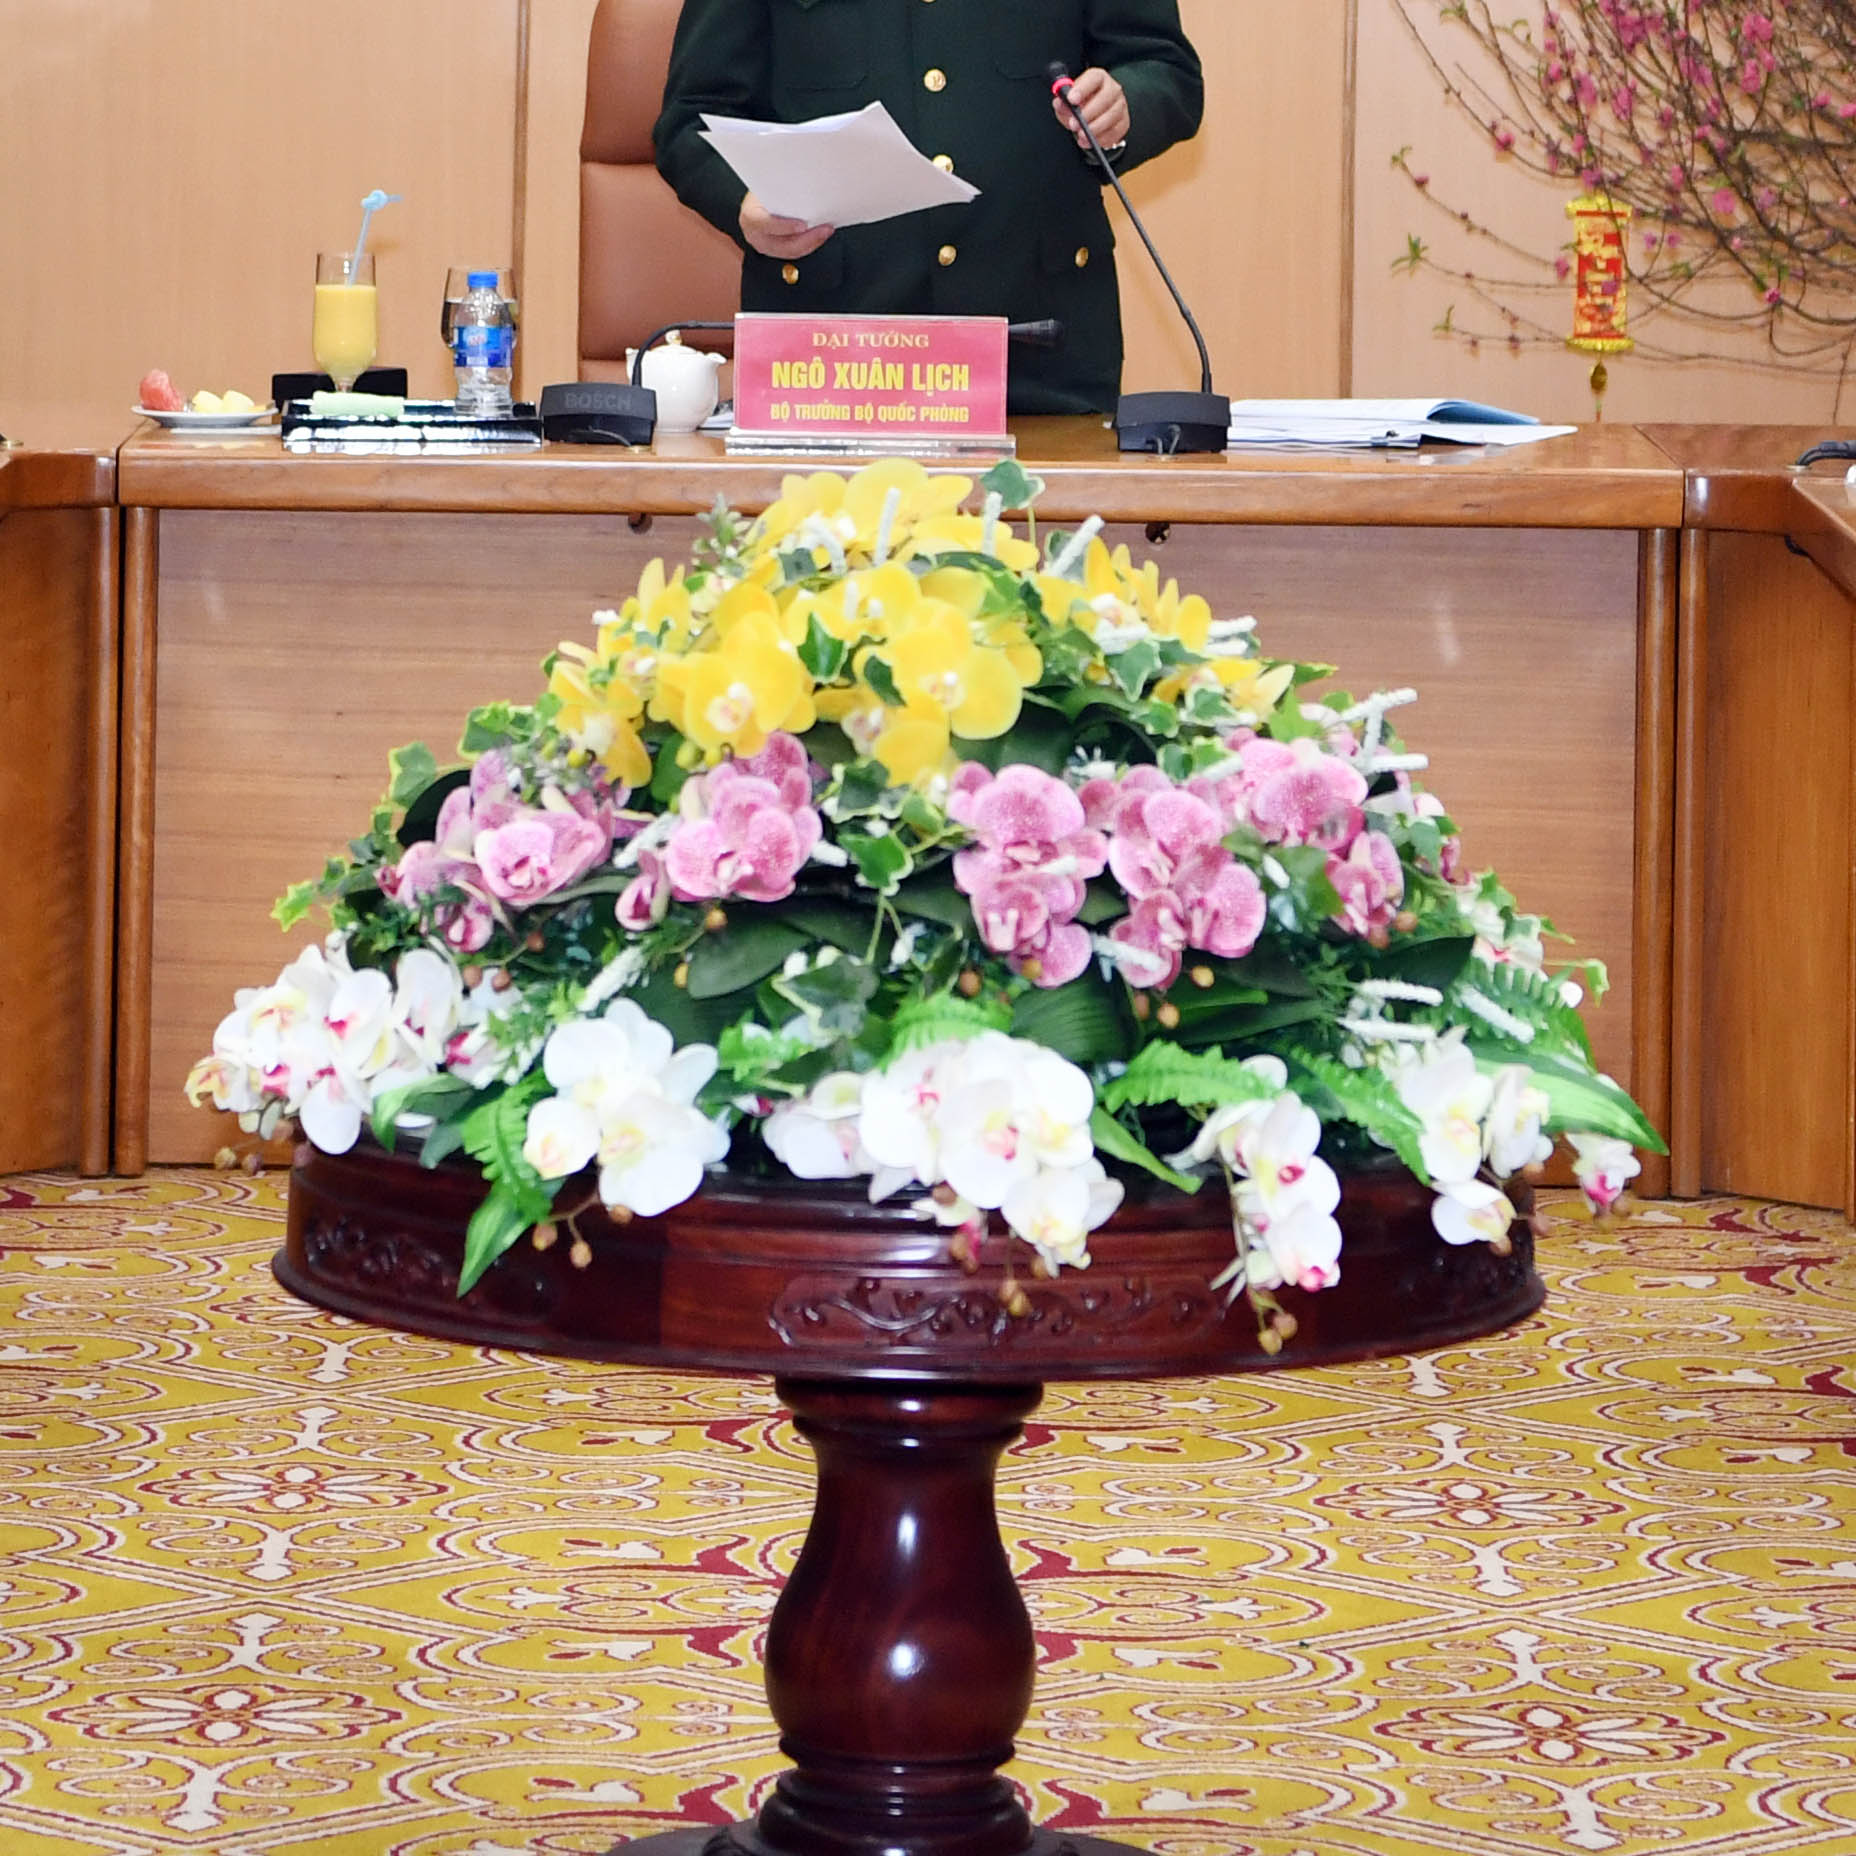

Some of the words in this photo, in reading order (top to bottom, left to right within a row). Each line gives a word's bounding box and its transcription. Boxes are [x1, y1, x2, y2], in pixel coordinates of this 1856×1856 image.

[771, 355, 826, 389] NGÔ
[833, 357, 905, 391] XUÂN
[912, 363, 969, 397] LỊCH
[565, 391, 632, 410] BOSCH
[770, 400, 790, 423] BỘ
[854, 402, 874, 424] BỘ
[877, 401, 916, 423] QUỐC
[920, 403, 969, 423] PHÒNG
